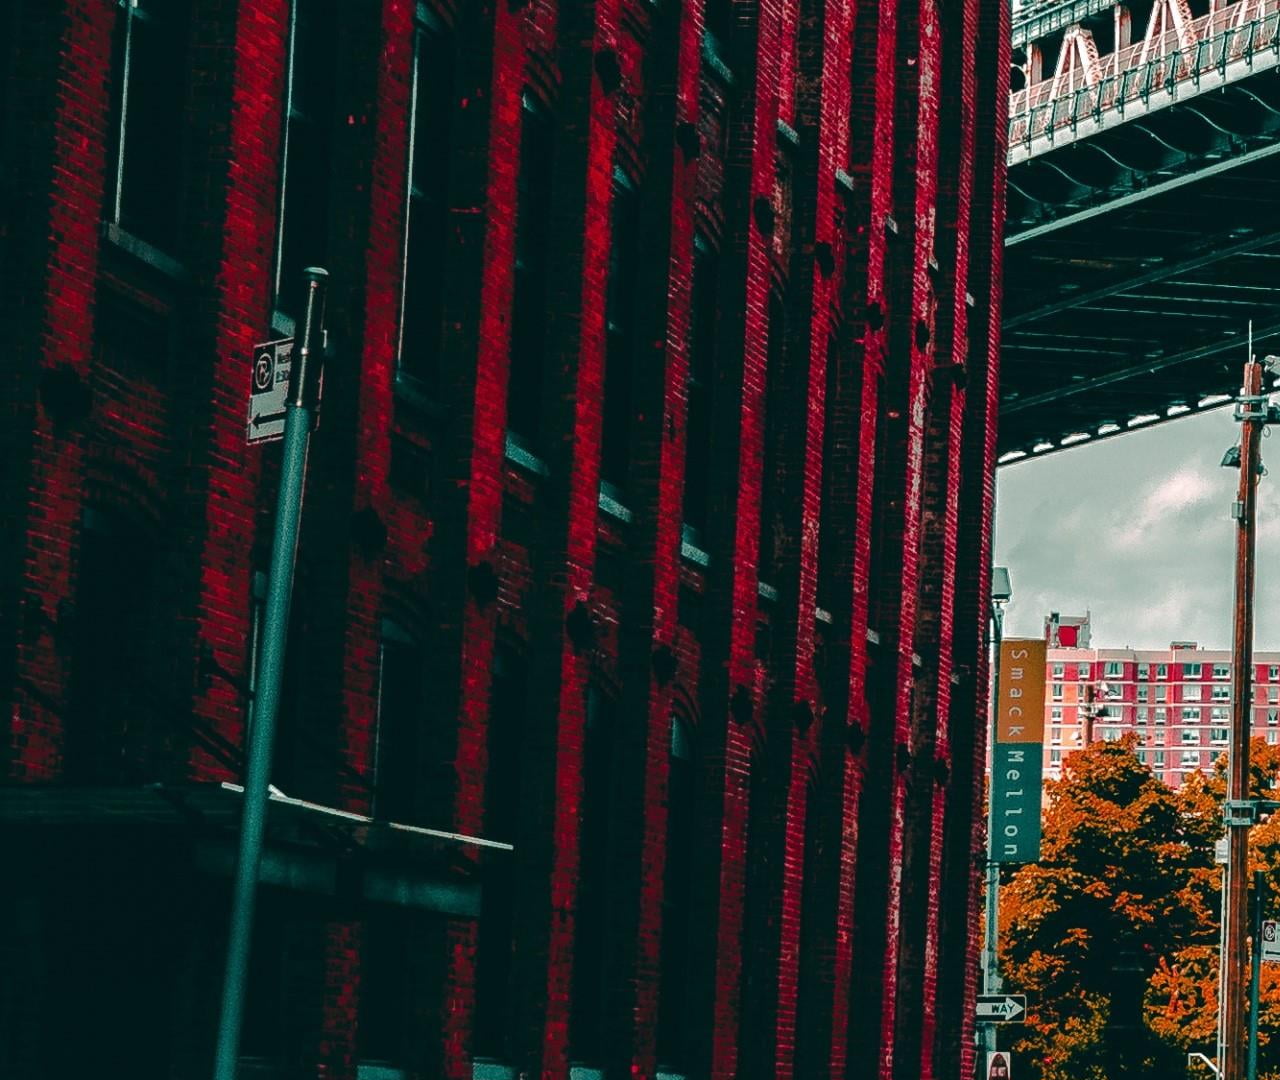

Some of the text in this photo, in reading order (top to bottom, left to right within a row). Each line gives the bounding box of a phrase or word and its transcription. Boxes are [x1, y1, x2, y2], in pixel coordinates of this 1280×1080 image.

[1004, 649, 1028, 855] Smack Mellon
[991, 1004, 1015, 1013] WAY
